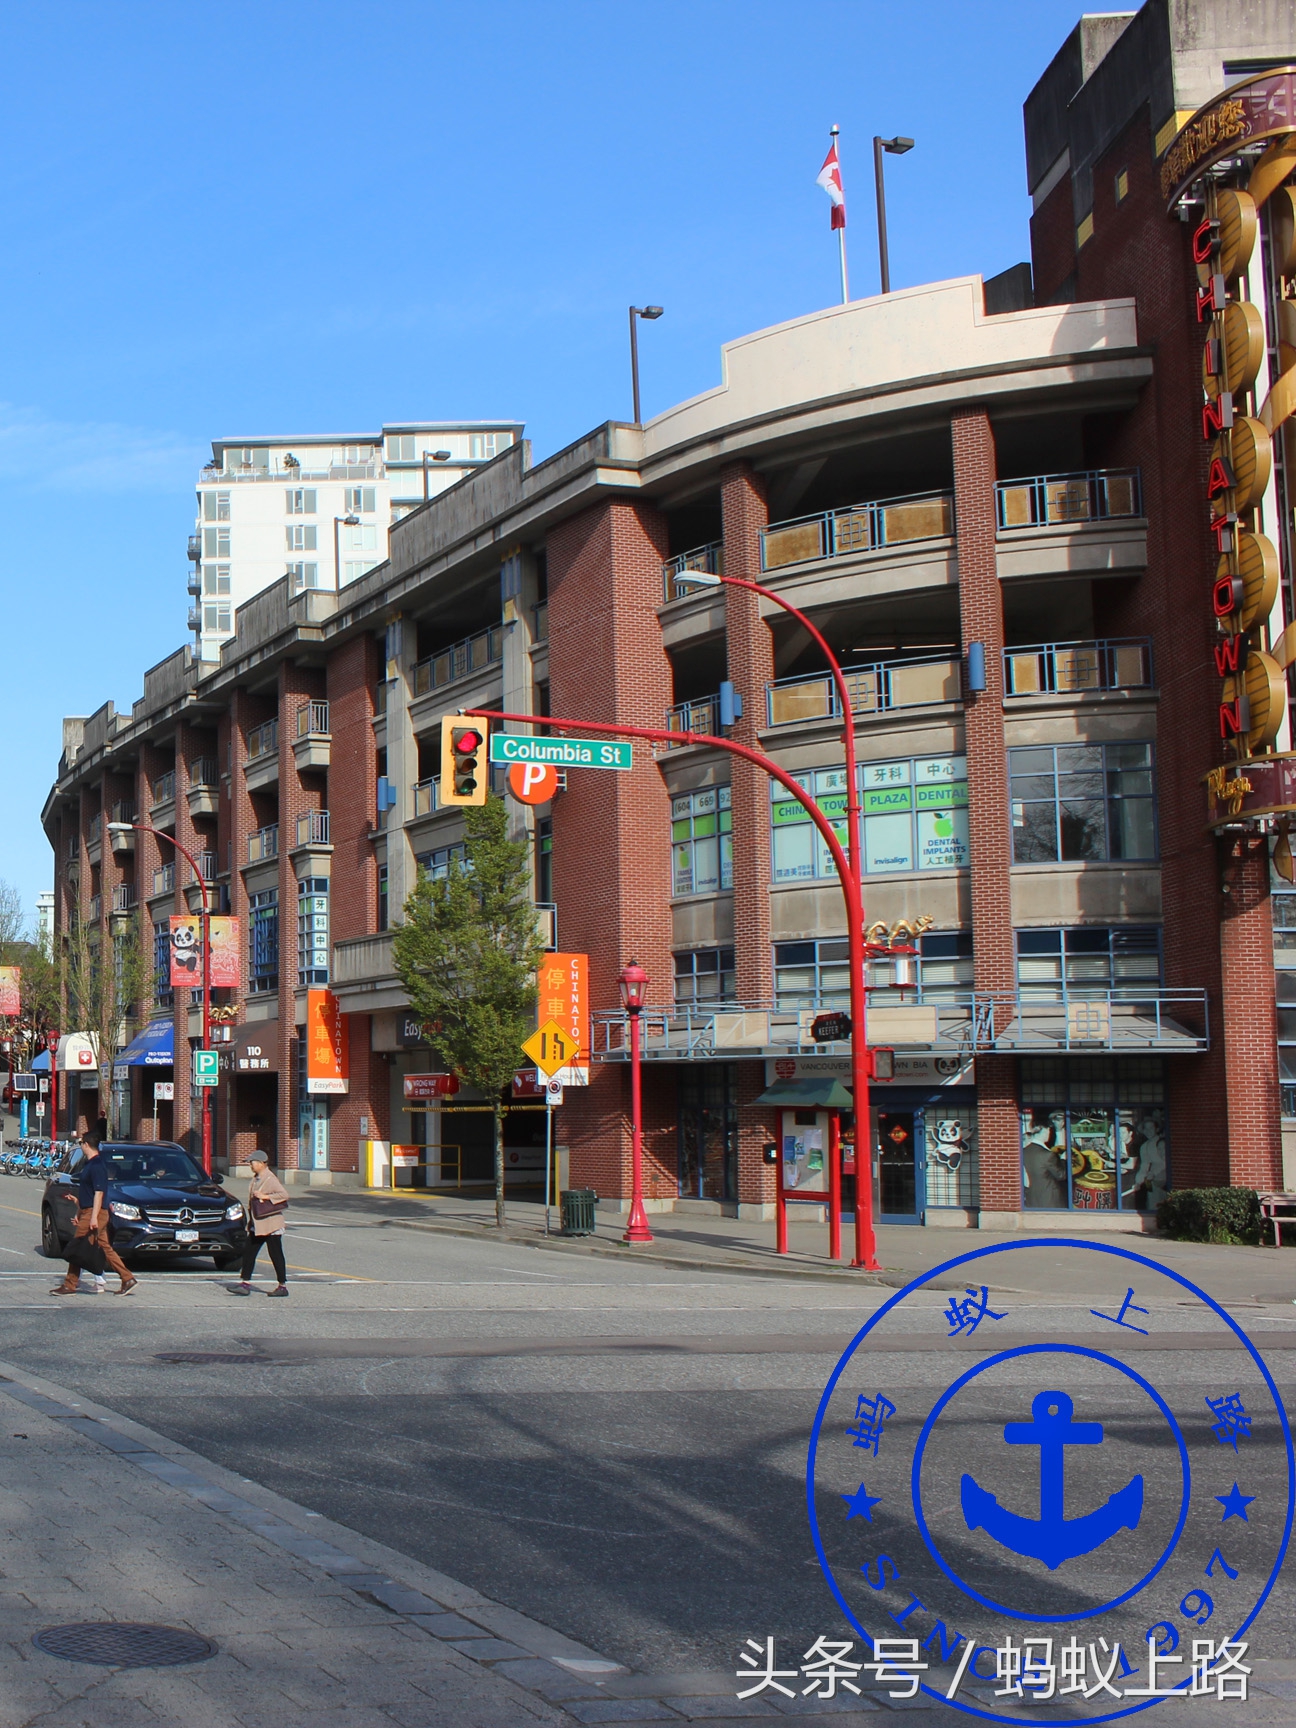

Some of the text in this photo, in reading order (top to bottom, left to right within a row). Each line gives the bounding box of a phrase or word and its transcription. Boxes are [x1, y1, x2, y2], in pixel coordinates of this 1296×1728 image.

[1193, 218, 1248, 740] CHINATOWN
[503, 739, 621, 764] Columbia St
[522, 763, 547, 796] P
[874, 767, 902, 782] 牙科
[927, 763, 955, 777] 中心
[870, 793, 908, 806] PLAZA
[918, 788, 968, 801] DENTAL
[923, 846, 966, 855] IMPLANTS
[874, 856, 908, 866] invisalign
[315, 899, 325, 963] 牙科中心
[818, 1025, 839, 1036] KEEFER
[247, 1046, 262, 1056] 110
[199, 1054, 215, 1072] P
[800, 1062, 851, 1070] VANCOUVER
[913, 1061, 929, 1069] BIA
[313, 1081, 344, 1090] EasyPark
